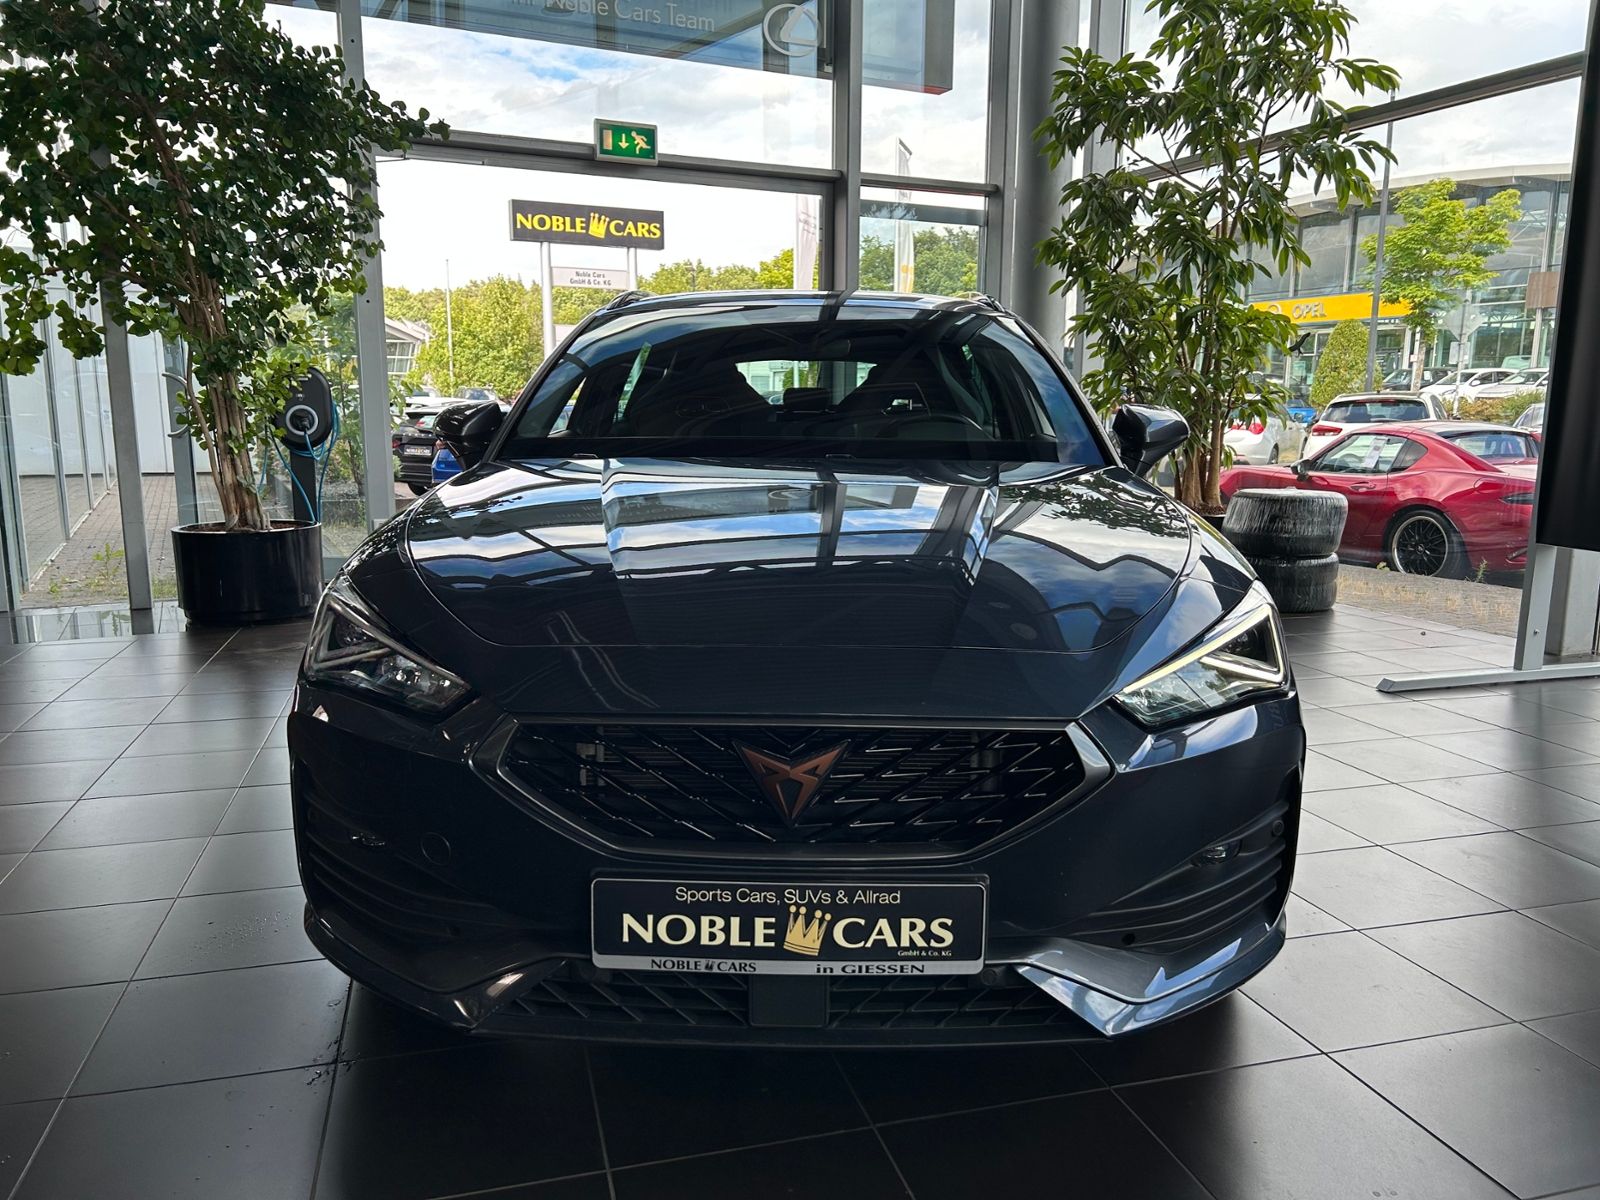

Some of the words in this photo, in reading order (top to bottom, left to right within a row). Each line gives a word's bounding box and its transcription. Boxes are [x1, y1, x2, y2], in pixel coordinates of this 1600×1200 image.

[614, 0, 662, 24] Cars
[666, 2, 715, 32] Team
[516, 213, 586, 233] NOBLE
[609, 219, 661, 238] CARS
[1292, 302, 1327, 319] OPEL
[675, 886, 732, 904] Sports
[736, 887, 780, 906] Cars,
[783, 888, 831, 904] SUVs
[835, 889, 849, 904] &
[852, 890, 901, 905] Allrad
[622, 912, 776, 948] NOBLE
[832, 917, 954, 949] CARS
[651, 959, 701, 971] NOBLE
[717, 961, 757, 972] CARS
[815, 964, 834, 974] in
[840, 964, 925, 974] GIESSEN
